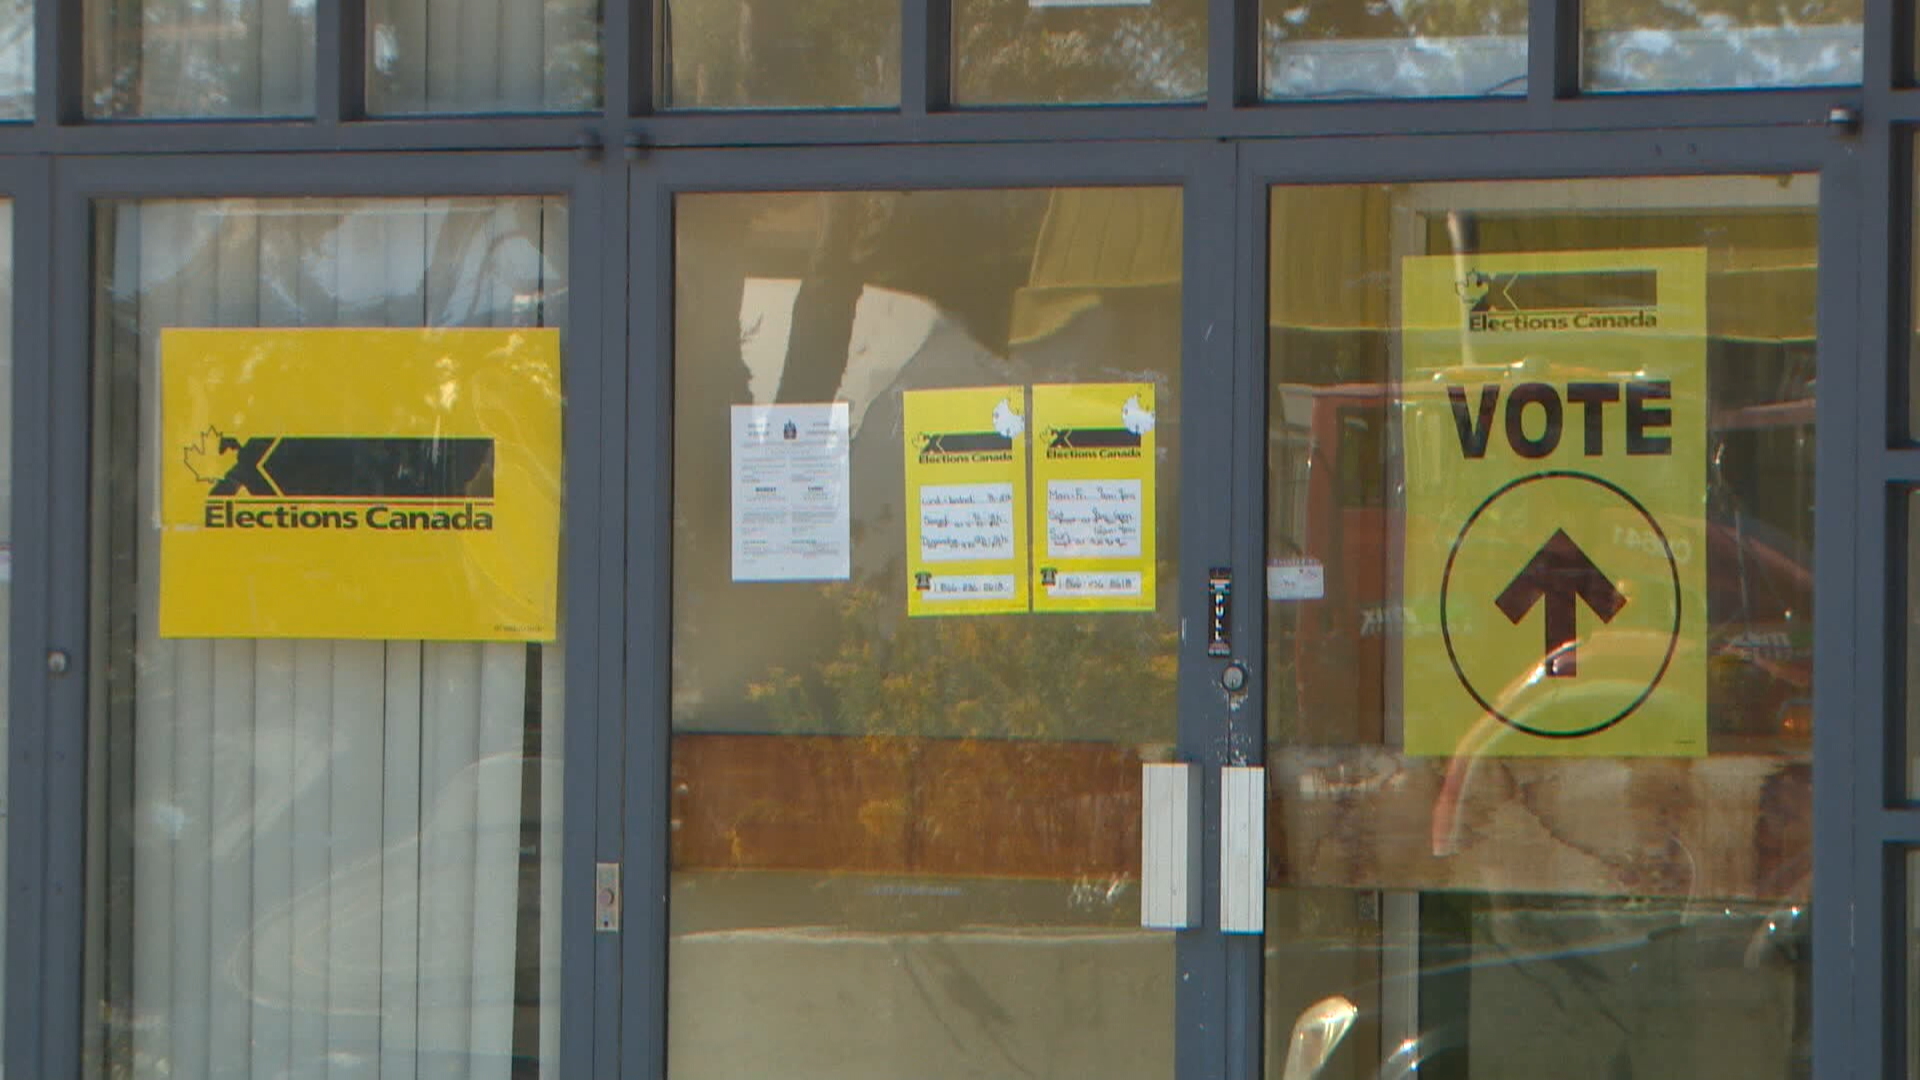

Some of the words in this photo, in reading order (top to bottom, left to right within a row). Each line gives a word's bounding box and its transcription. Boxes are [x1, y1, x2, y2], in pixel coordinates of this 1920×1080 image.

[1469, 313, 1569, 332] Elections
[1573, 310, 1657, 329] Canada
[1446, 380, 1672, 459] VOTE
[918, 453, 970, 464] Elections
[972, 453, 1013, 463] Canada
[1046, 449, 1098, 460] Elections
[1099, 448, 1141, 459] Canada
[203, 502, 359, 530] Elections
[364, 502, 494, 531] Canada
